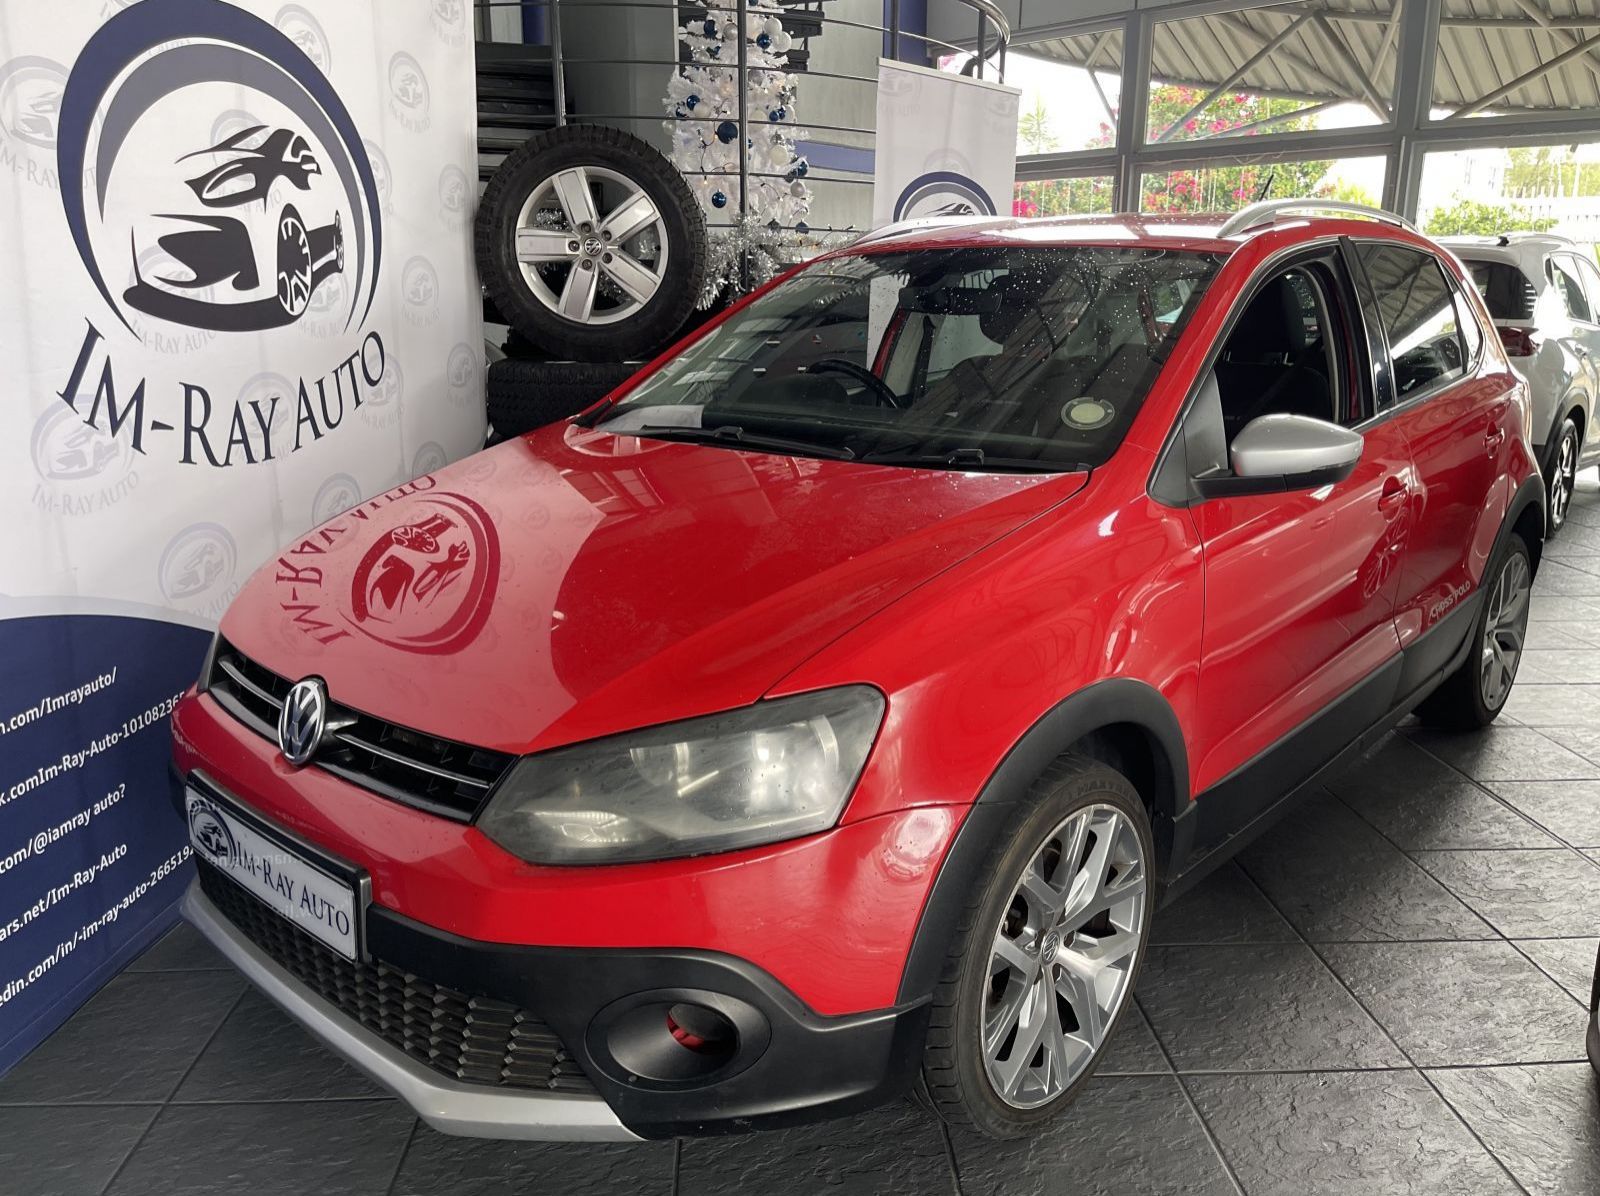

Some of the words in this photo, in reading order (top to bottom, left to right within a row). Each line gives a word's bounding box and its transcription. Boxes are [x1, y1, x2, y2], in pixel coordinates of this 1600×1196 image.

[56, 317, 281, 467] IM-RAY
[292, 331, 386, 453] AUTO
[32, 483, 94, 516] IM-RAY
[98, 471, 138, 511] AUTO
[93, 783, 126, 815] auto?
[237, 841, 294, 901] IM-RAY
[300, 885, 349, 936] AUTO
